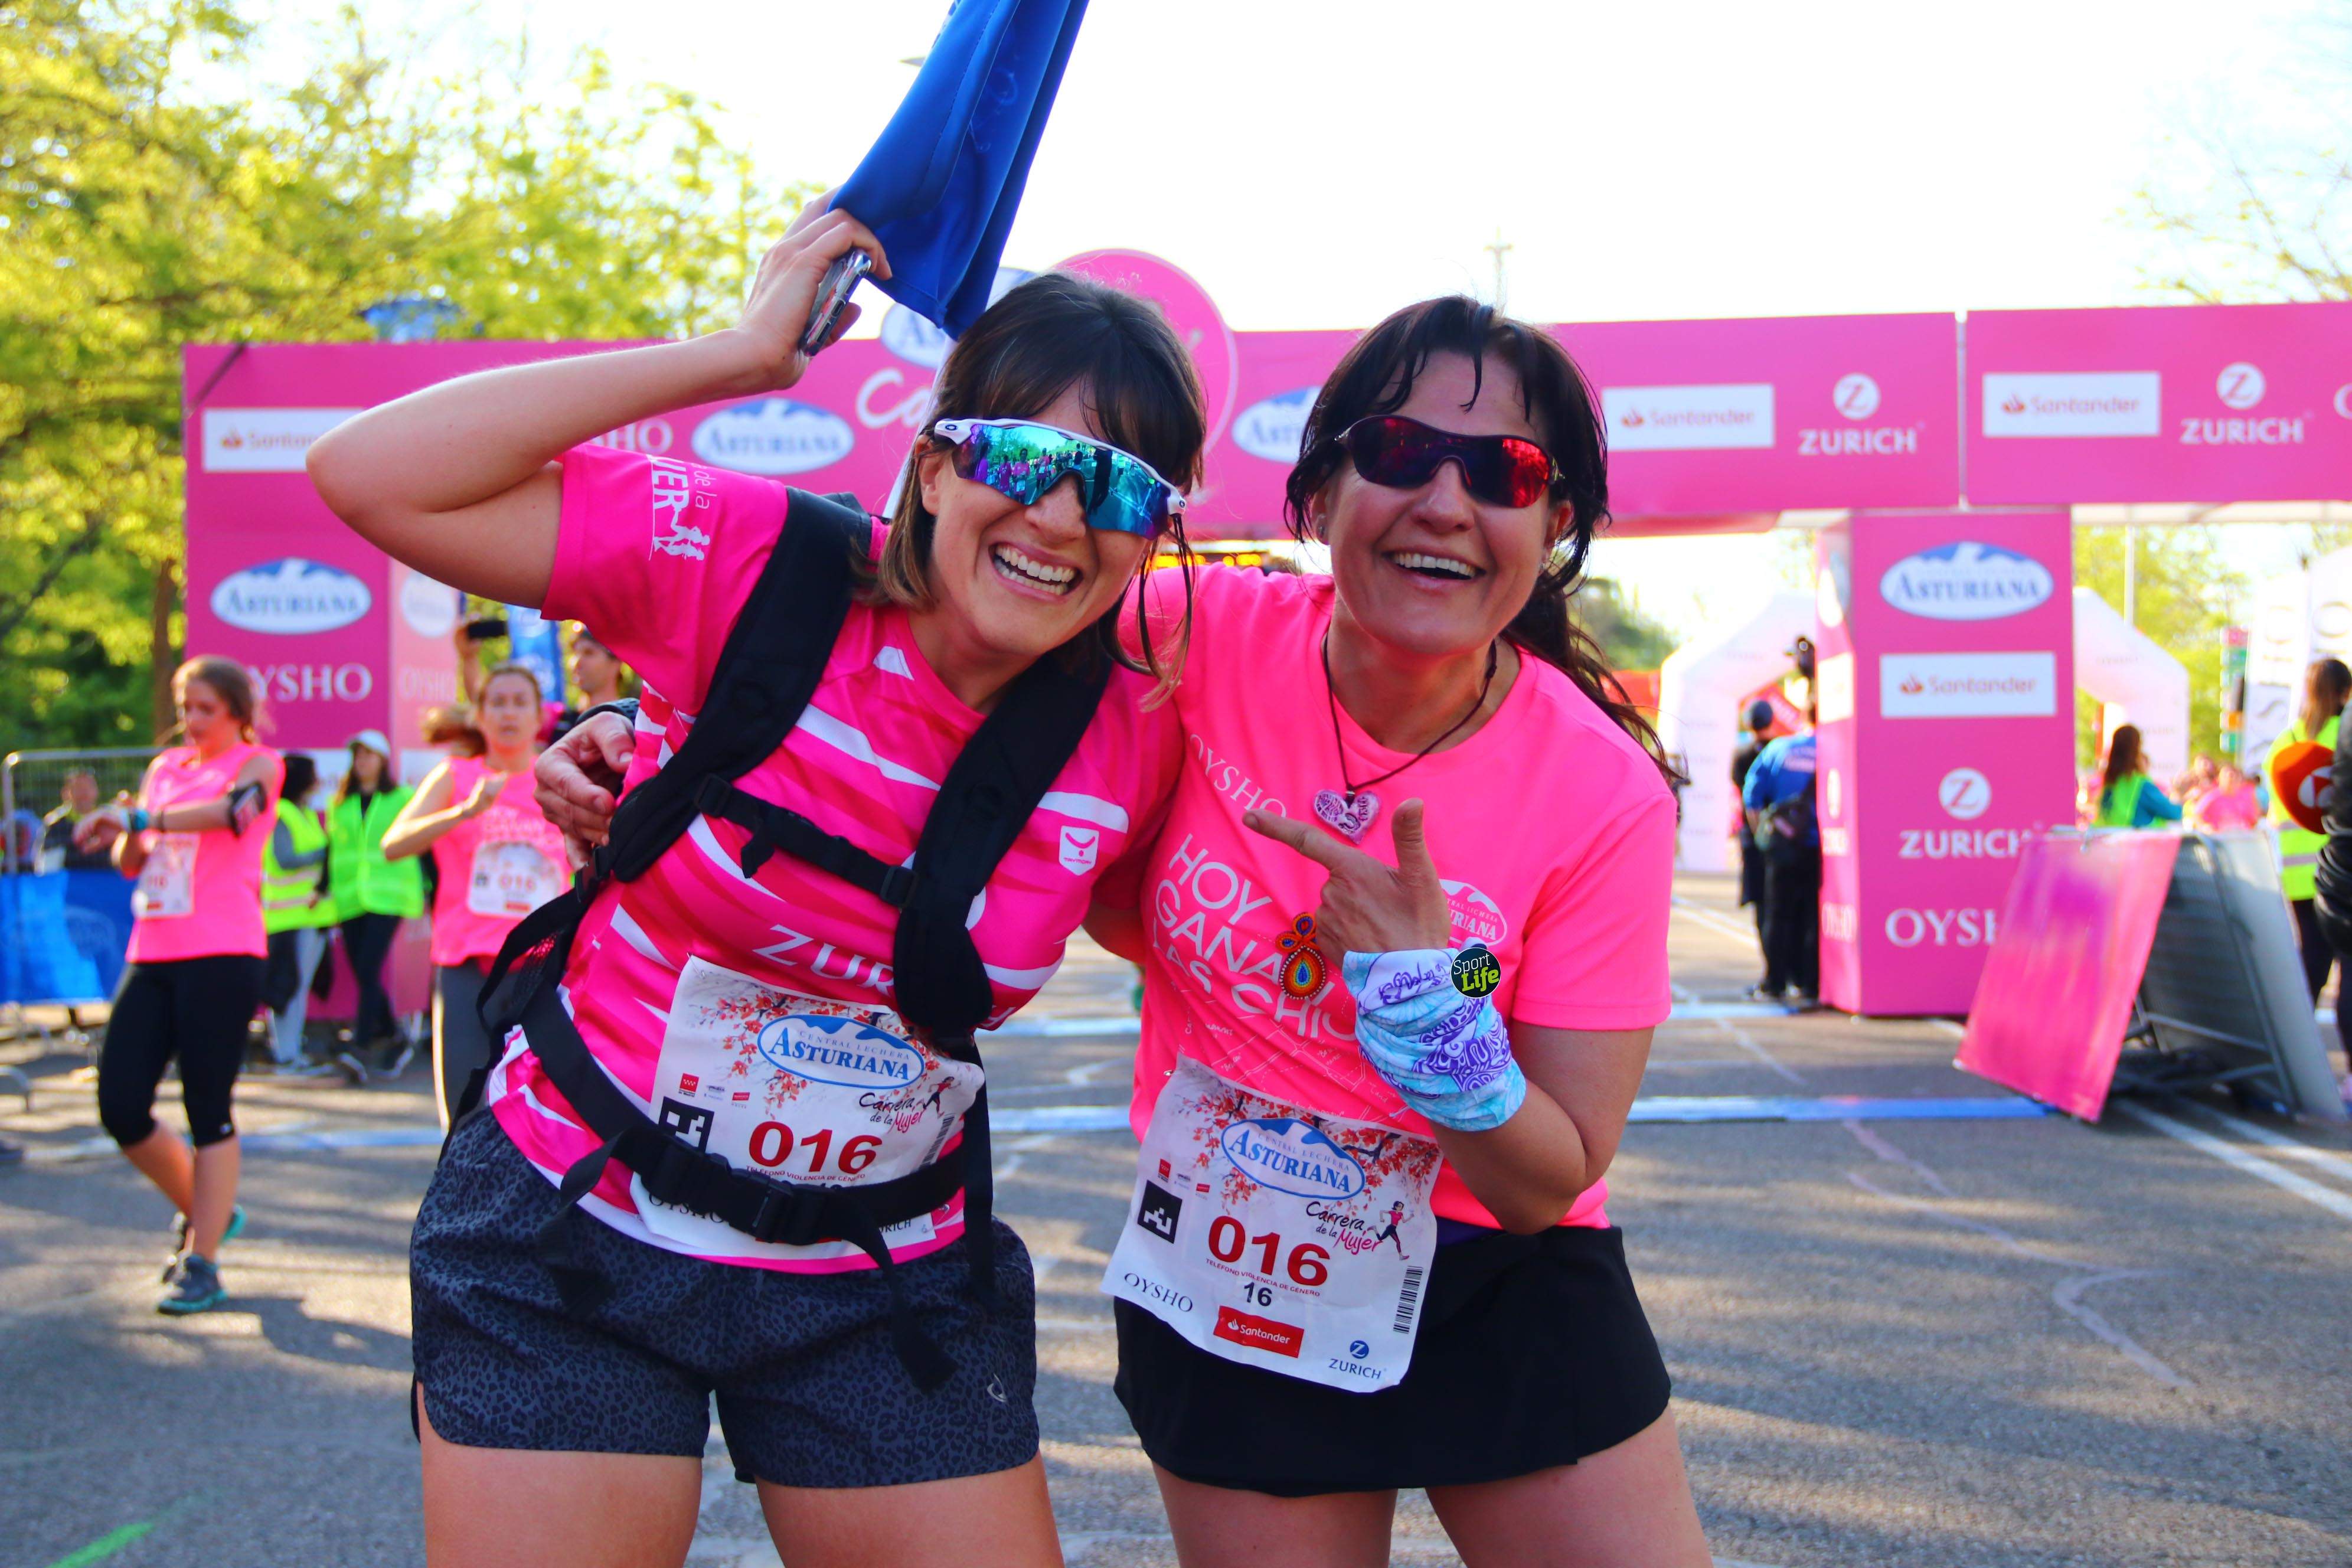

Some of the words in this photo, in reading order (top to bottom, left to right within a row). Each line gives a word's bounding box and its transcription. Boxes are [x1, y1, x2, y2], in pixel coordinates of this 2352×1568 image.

[1651, 409, 1755, 427] Santander
[2030, 395, 2139, 414] Santander
[710, 427, 841, 455] ASTURIANA
[1798, 427, 1916, 456] ZURICH
[2180, 418, 2304, 445] ZURICH
[695, 489, 717, 509] la
[1895, 573, 2038, 600] ASTURIANA
[227, 588, 360, 615] ASTURIANA
[248, 662, 373, 703] YSHO
[1928, 676, 2037, 694] Santander
[1169, 833, 1273, 925] HOY
[1446, 898, 1465, 910] TRAL
[752, 924, 894, 998] ZUR
[1231, 982, 1357, 1041] CHIC
[768, 1027, 909, 1080] ASTURIANA
[800, 1031, 851, 1049] CENTRAL
[857, 1043, 910, 1060] LECHERA
[859, 1093, 914, 1113] Carrera
[870, 1112, 881, 1123] de
[883, 1113, 893, 1125] la
[887, 1108, 925, 1134] Mujer
[748, 1121, 883, 1174] 016
[1229, 1129, 1351, 1193] ASTURIANA
[1258, 1133, 1298, 1154] CENTRAL
[1302, 1150, 1350, 1171] LECHERA
[786, 1171, 825, 1181] VIOLENCIA
[1306, 1201, 1366, 1231] Carrera
[1207, 1215, 1331, 1286] 016
[1315, 1223, 1327, 1235] de
[1328, 1226, 1338, 1239] la
[1333, 1228, 1384, 1256] Mujer
[1123, 1273, 1193, 1312] OYSHO
[1241, 1271, 1278, 1288] VIOLENCIA
[1243, 1281, 1273, 1307] 16
[1239, 1324, 1291, 1345] Santander
[1328, 1358, 1382, 1380] ZURICH
